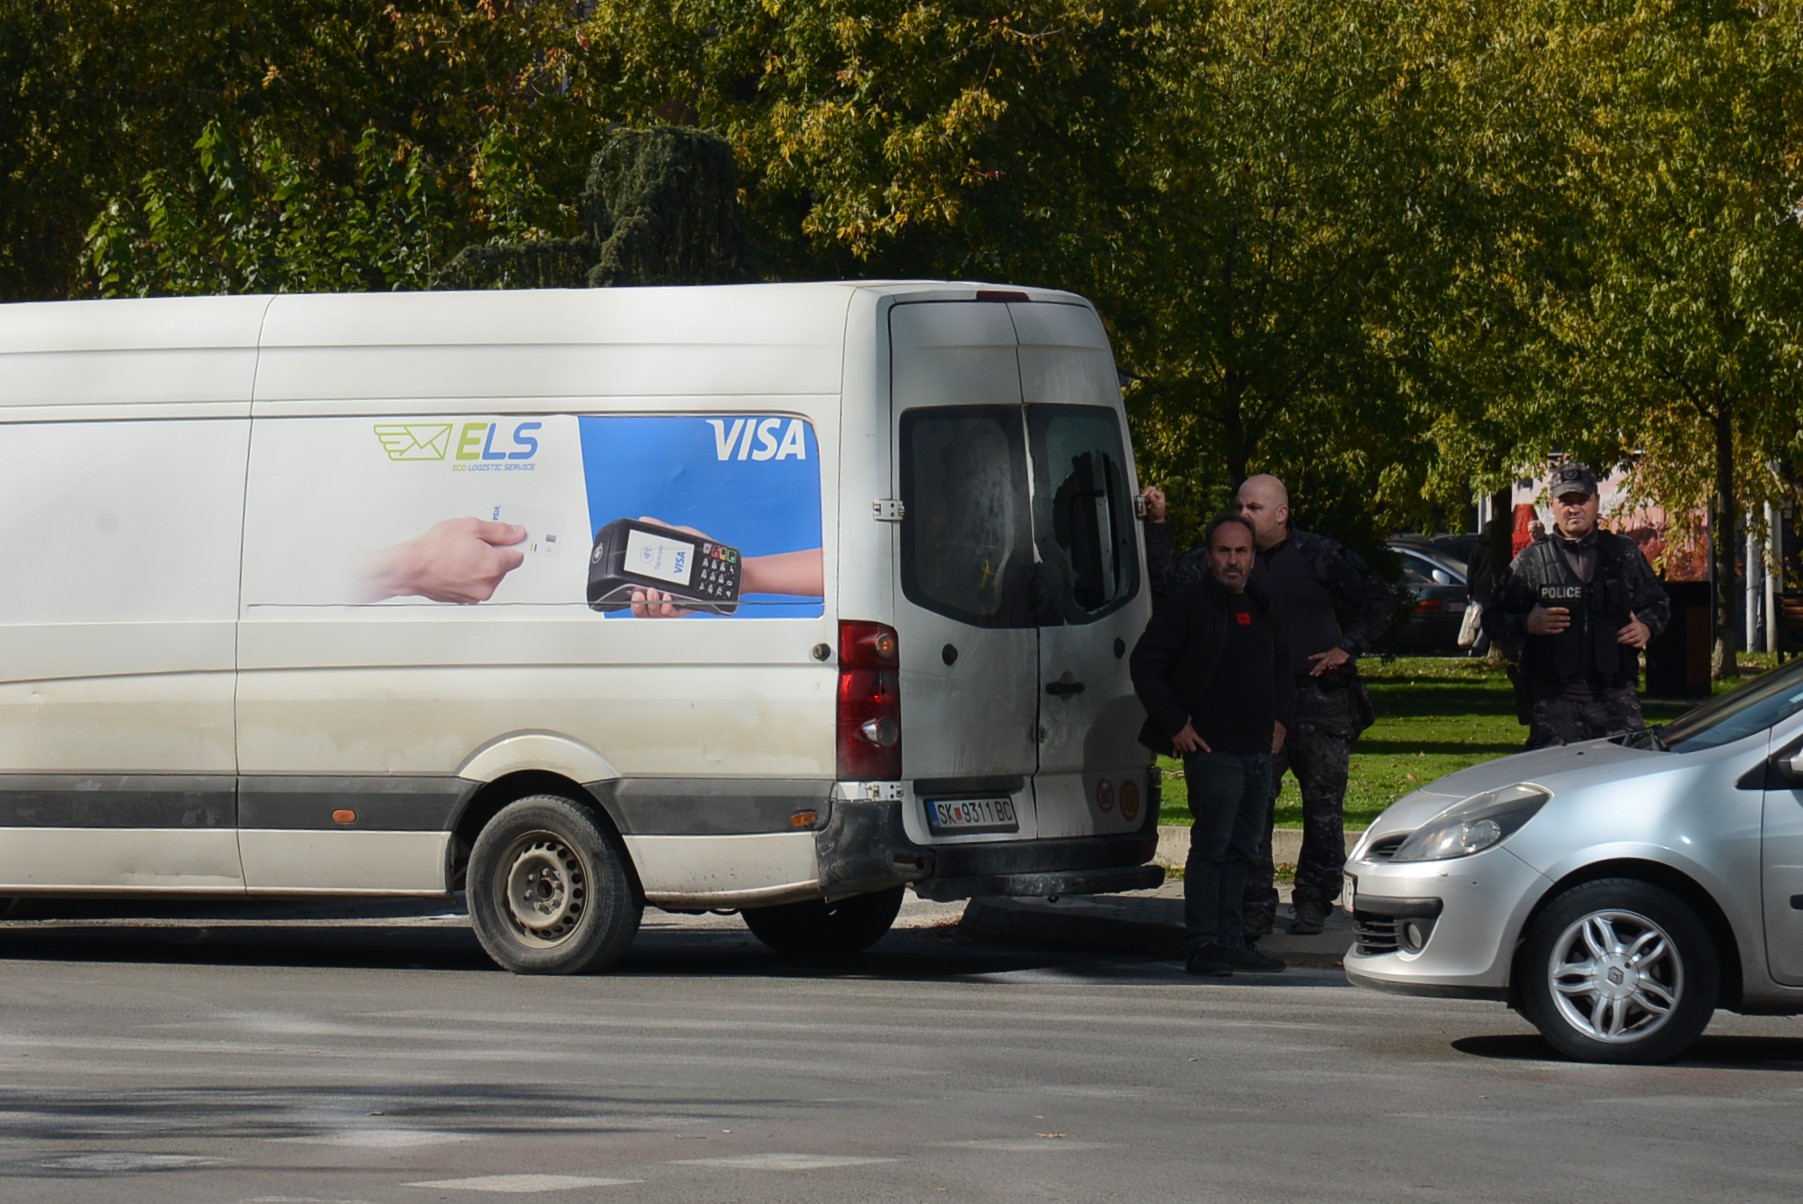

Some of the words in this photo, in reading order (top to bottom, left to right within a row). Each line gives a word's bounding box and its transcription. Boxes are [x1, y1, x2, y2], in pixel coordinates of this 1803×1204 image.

[455, 422, 543, 460] ELS
[705, 418, 806, 461] VISA
[452, 463, 467, 472] ECO
[468, 463, 503, 472] LOGISTIC
[504, 463, 536, 472] SERVICE
[674, 551, 686, 574] VISA
[1541, 586, 1582, 599] POLICE
[937, 803, 957, 825] SK
[961, 801, 995, 823] 9311
[994, 800, 1013, 821] BC
